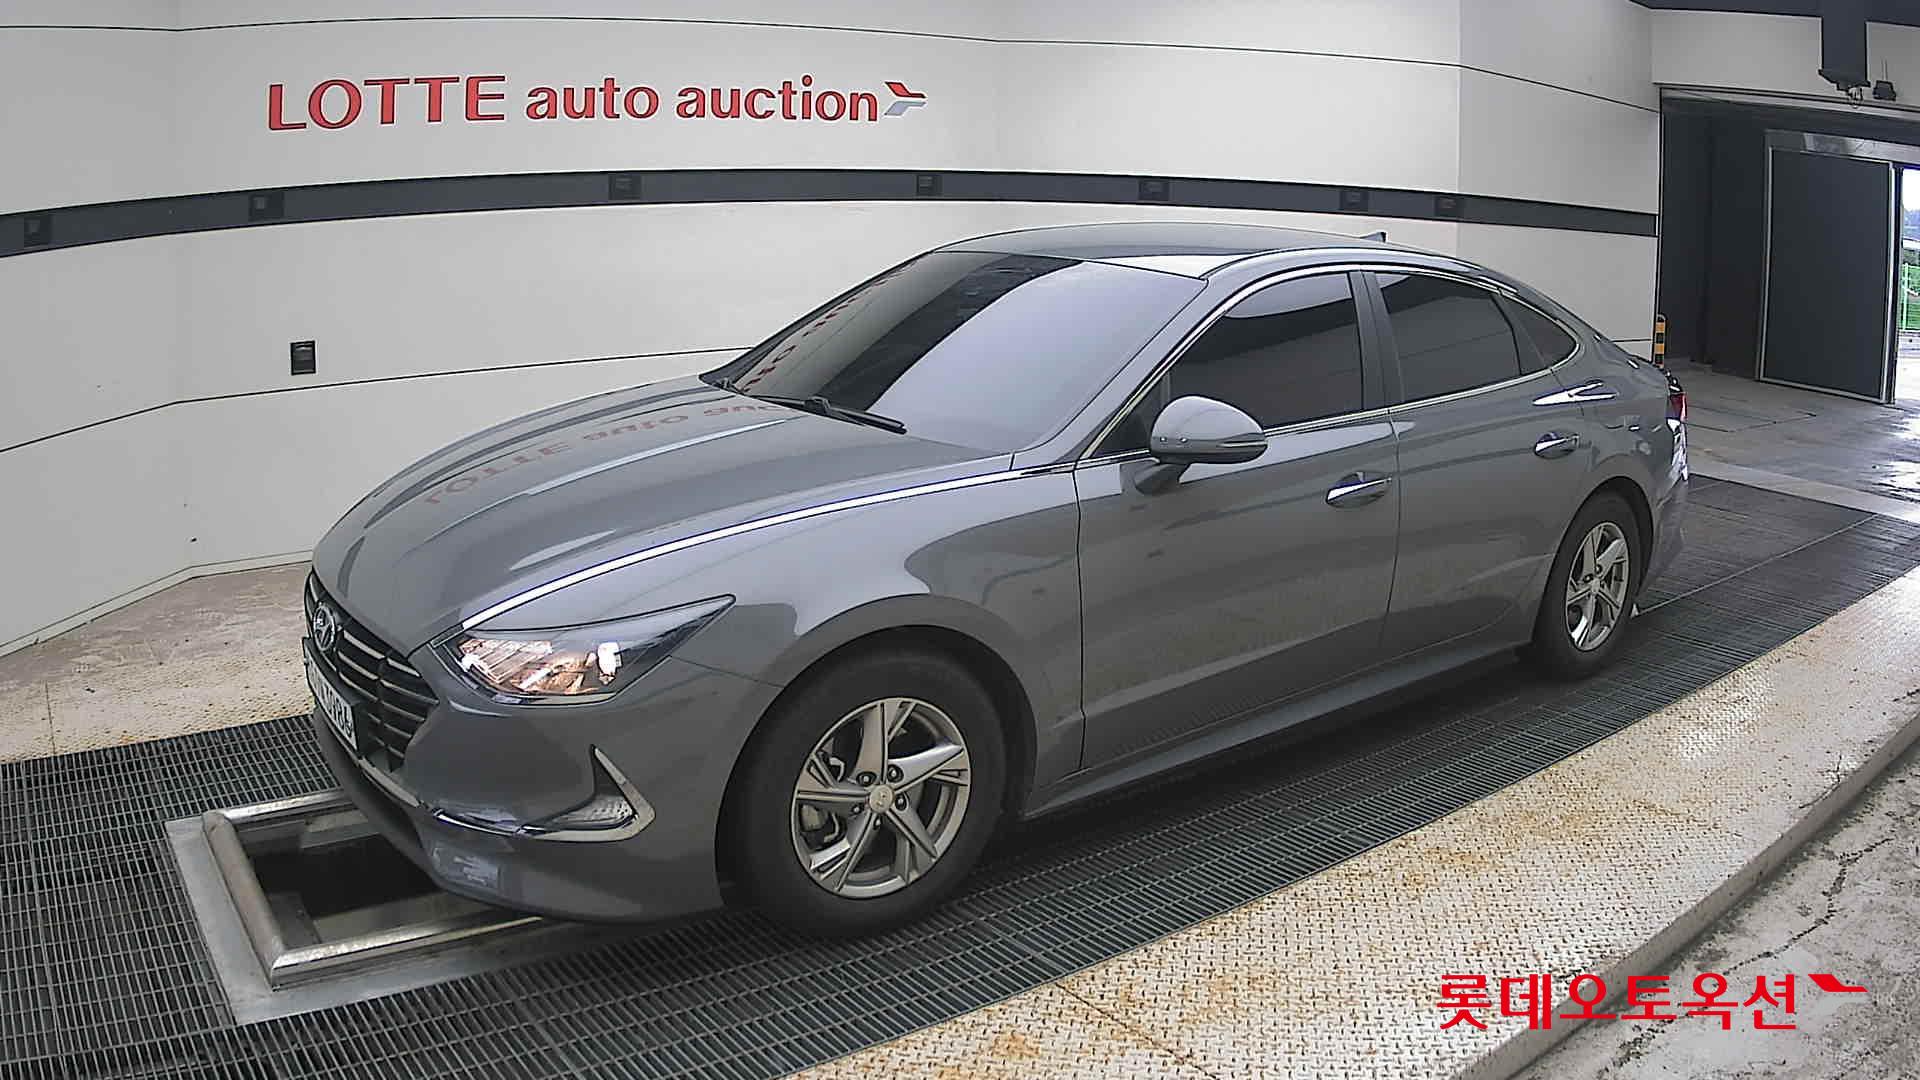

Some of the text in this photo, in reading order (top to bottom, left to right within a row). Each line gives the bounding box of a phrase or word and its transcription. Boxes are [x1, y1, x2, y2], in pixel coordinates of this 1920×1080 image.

[267, 74, 880, 131] LOTTE auto auction
